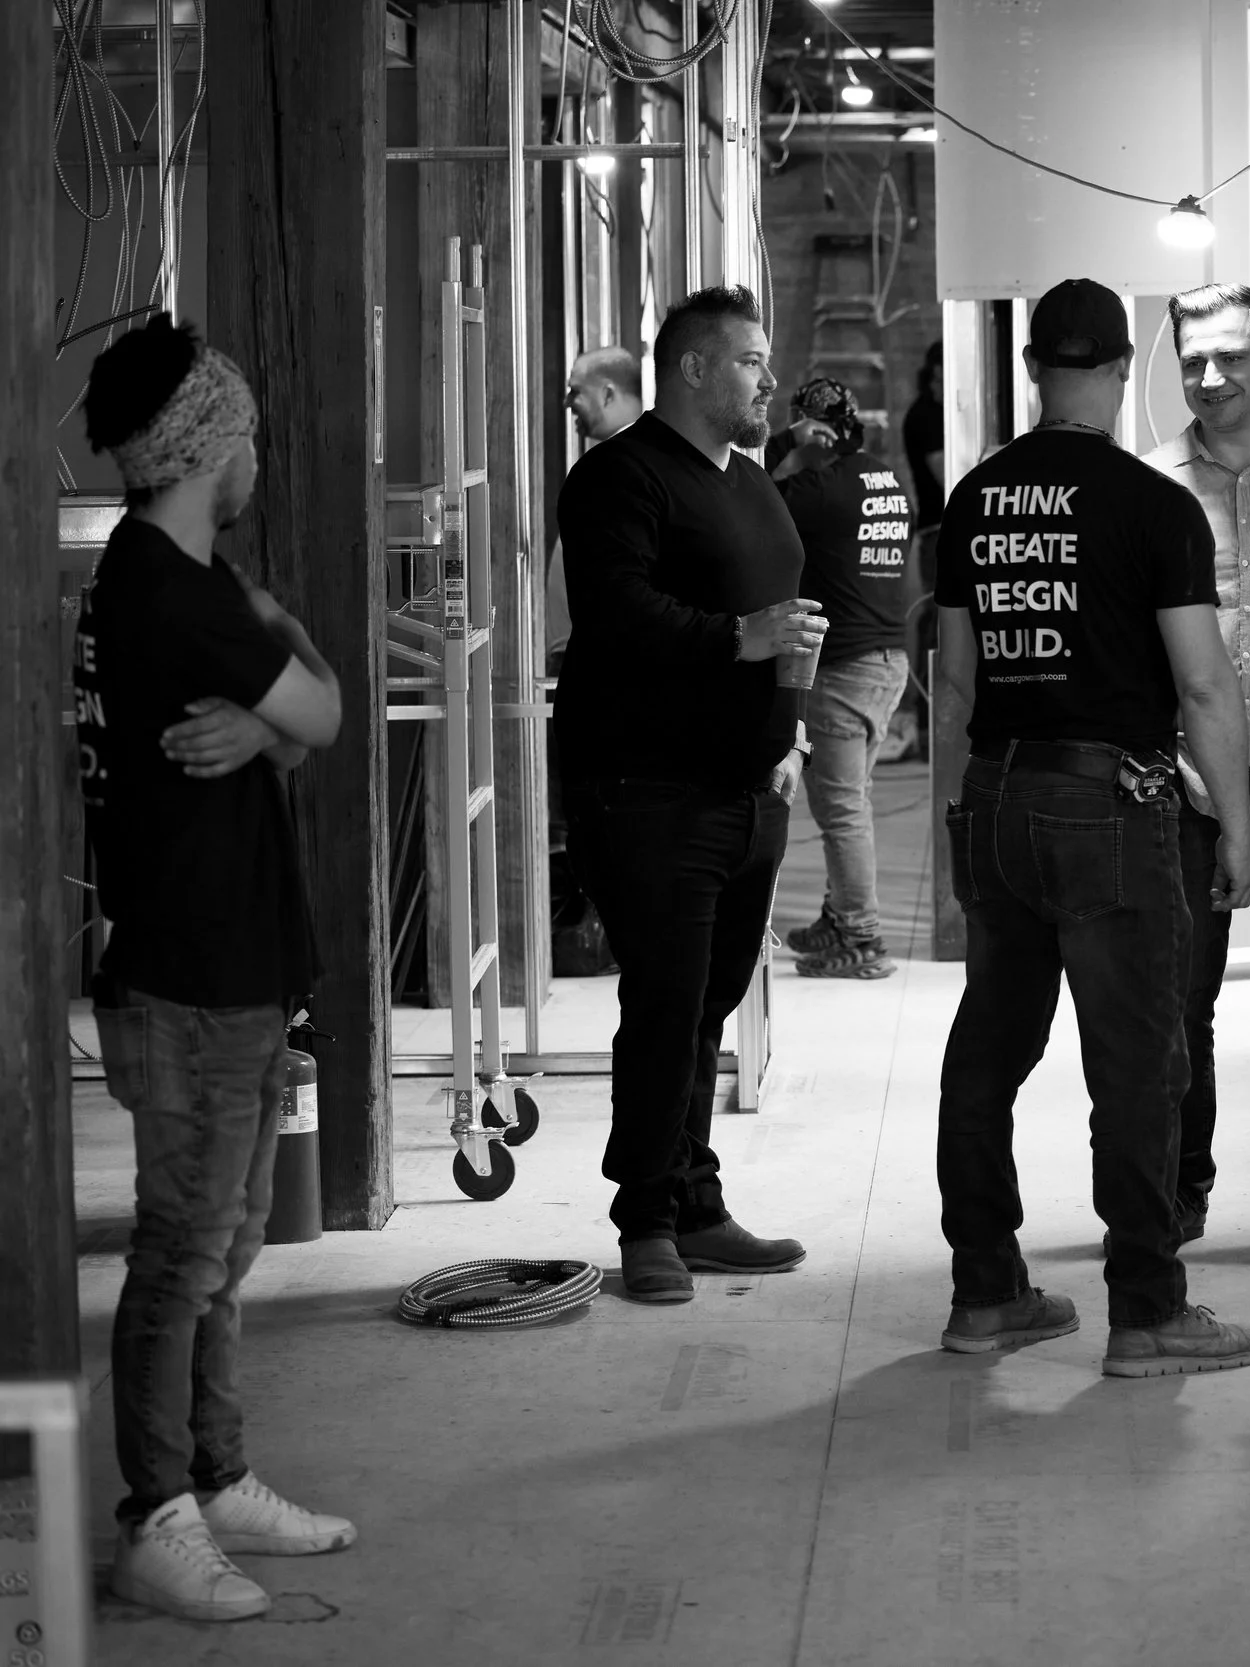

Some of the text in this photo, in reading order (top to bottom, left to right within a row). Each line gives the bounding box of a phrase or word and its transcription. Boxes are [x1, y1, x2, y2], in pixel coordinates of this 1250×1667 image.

[859, 471, 900, 490] THINK
[861, 495, 909, 517] CREATE
[981, 485, 1080, 516] THINK
[857, 520, 909, 541] DESIGN
[859, 546, 904, 565] BUILD.
[970, 532, 1079, 566] CREATE
[975, 580, 1078, 614] DESGN
[981, 627, 1072, 660] BUID.
